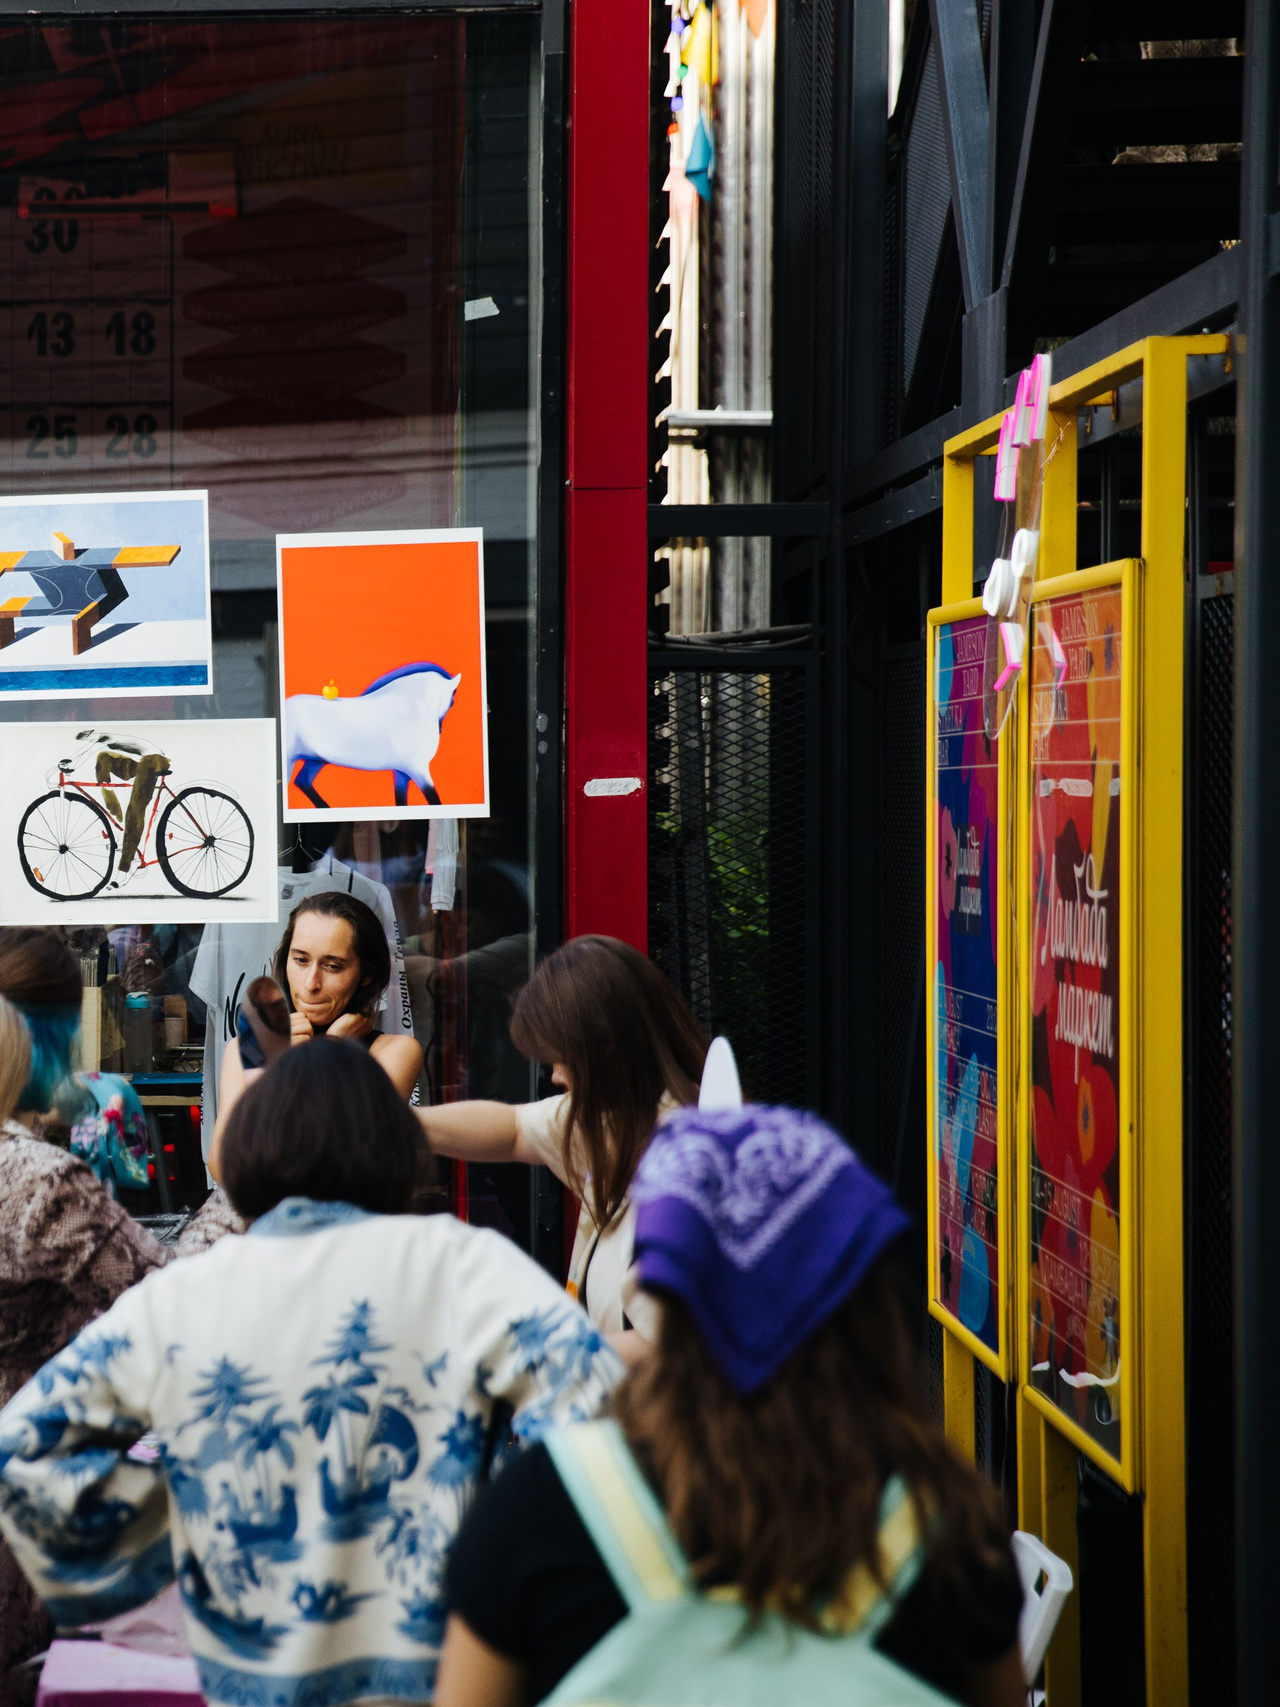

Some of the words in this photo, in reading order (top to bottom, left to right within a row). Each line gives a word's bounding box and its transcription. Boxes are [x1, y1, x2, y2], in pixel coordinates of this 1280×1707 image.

[25, 200, 81, 254] 30
[27, 312, 75, 356] 13
[105, 311, 156, 356] 18
[25, 414, 78, 460] 25
[104, 413, 157, 460] 28
[1061, 602, 1099, 641] JAMESON
[1068, 646, 1090, 680] YARD
[398, 970, 413, 1030] Охраны
